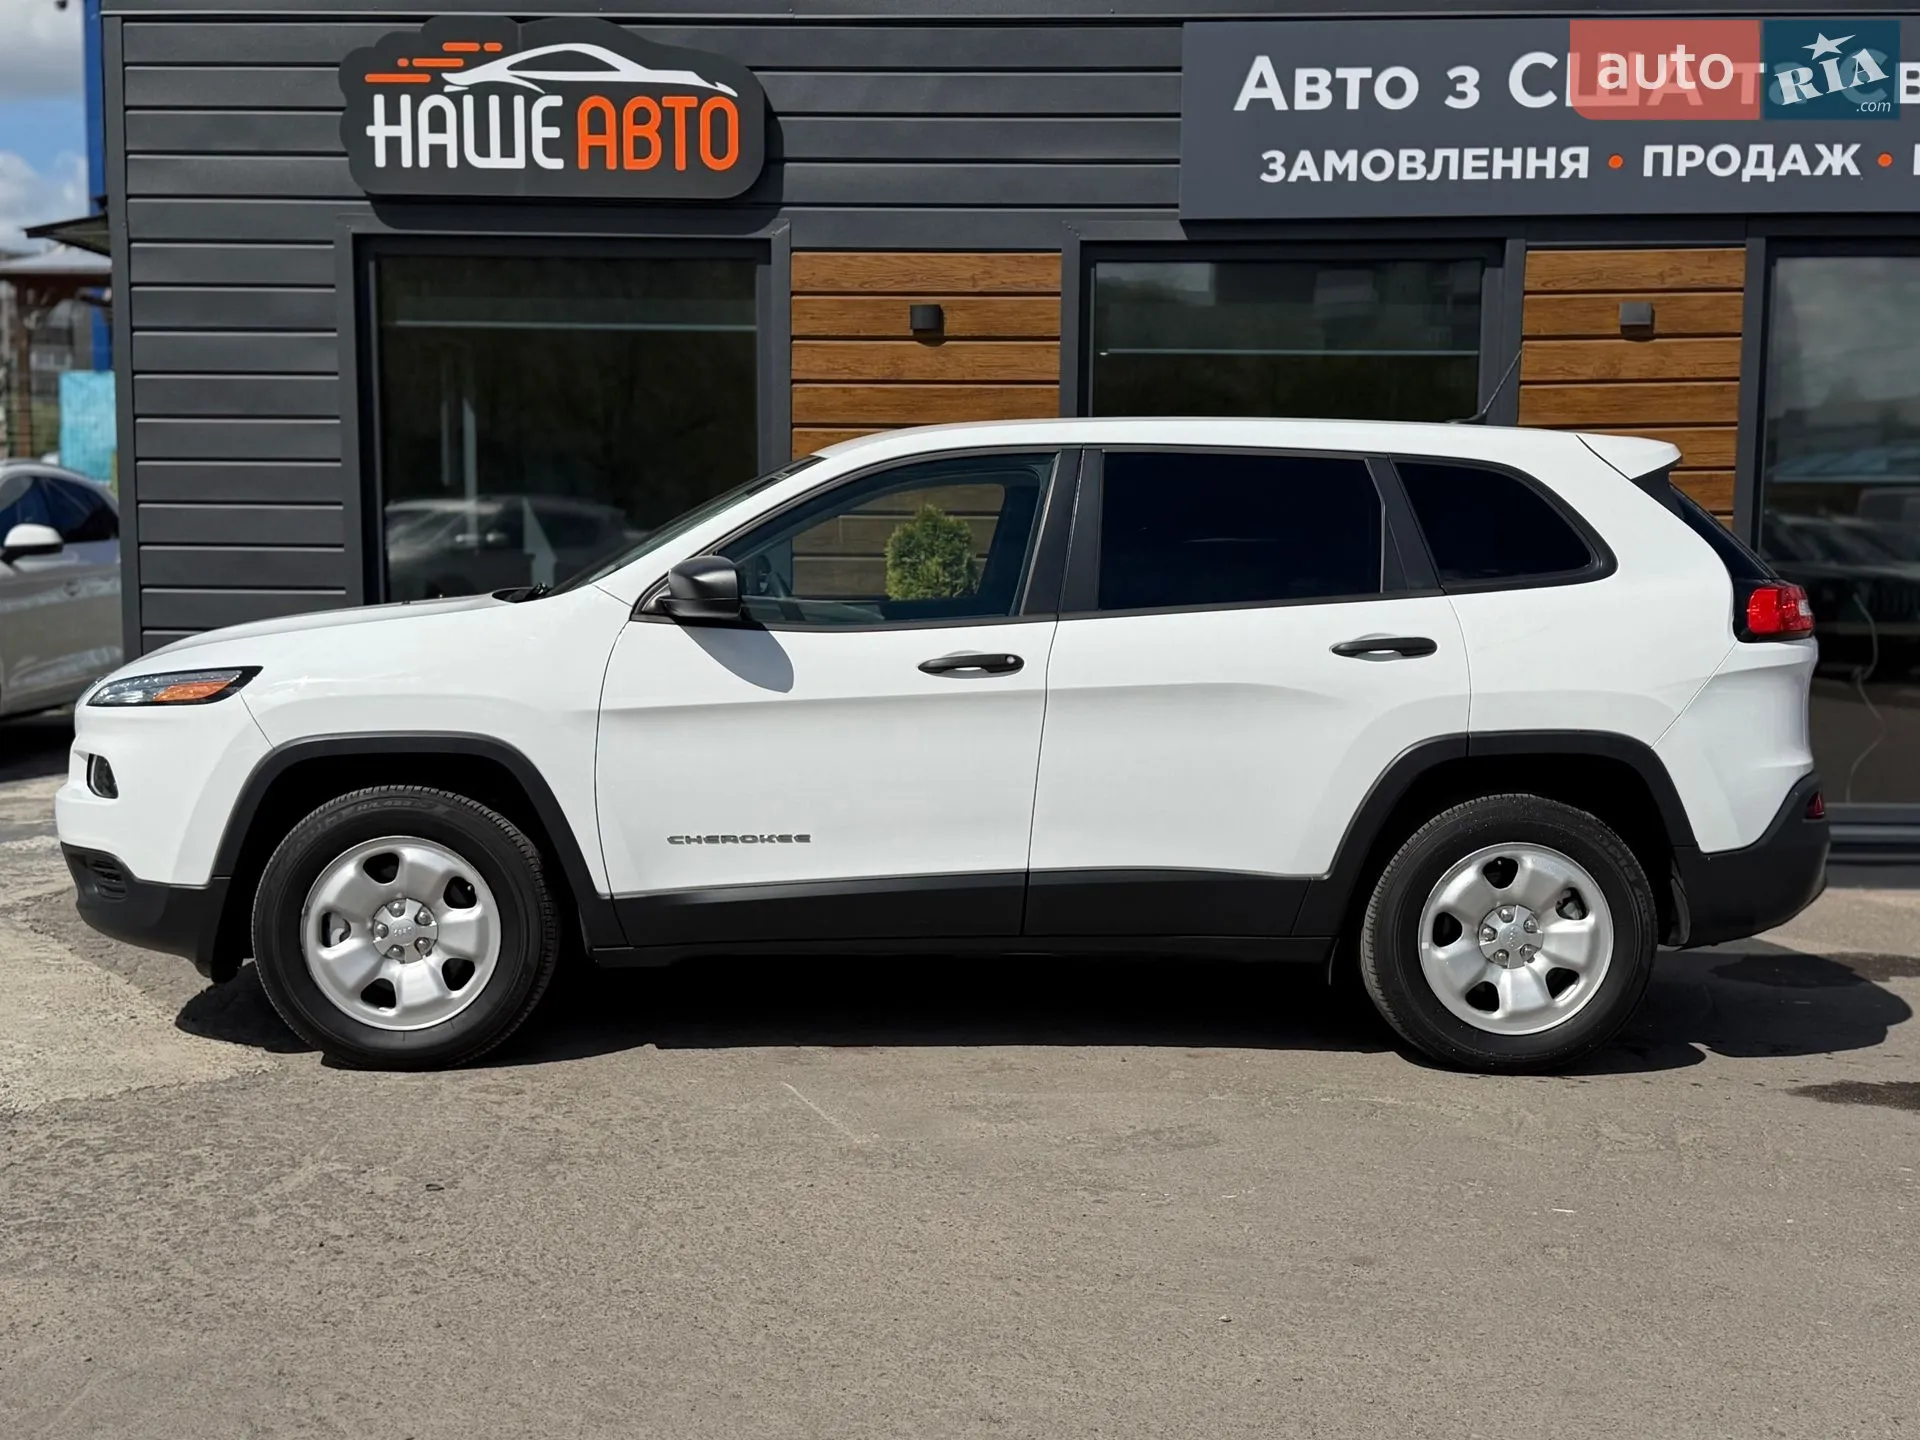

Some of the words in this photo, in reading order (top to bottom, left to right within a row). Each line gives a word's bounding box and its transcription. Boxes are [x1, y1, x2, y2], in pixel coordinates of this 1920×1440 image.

[1233, 55, 1420, 111] Авто
[366, 94, 565, 170] НАШЕ
[577, 95, 739, 171] АВТО
[1260, 146, 1590, 183] ЗАМОВЛЕННЯ
[1643, 143, 1863, 182] ПРОДАЖ
[667, 834, 812, 845] CHEROKEE
